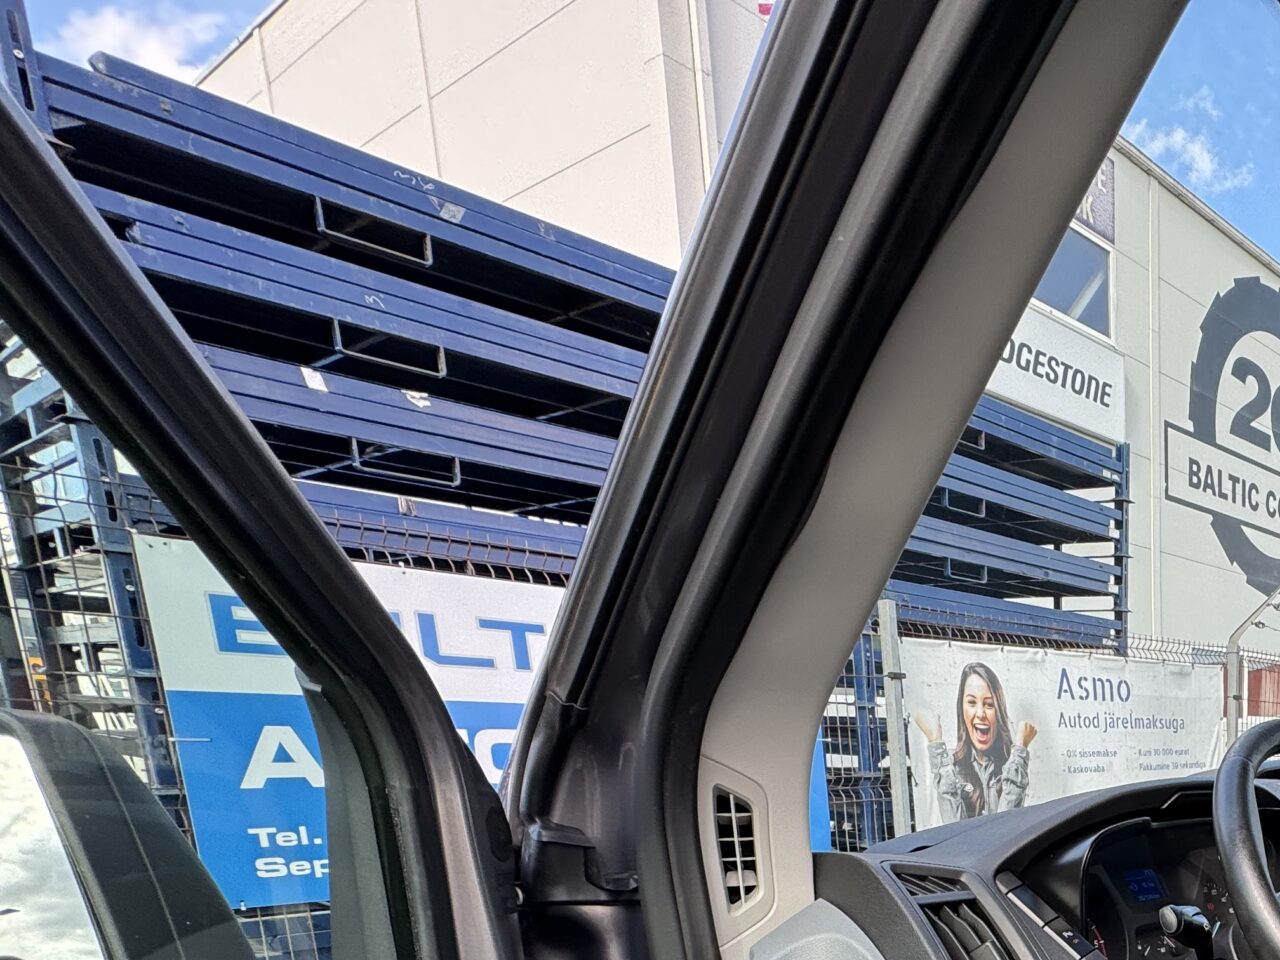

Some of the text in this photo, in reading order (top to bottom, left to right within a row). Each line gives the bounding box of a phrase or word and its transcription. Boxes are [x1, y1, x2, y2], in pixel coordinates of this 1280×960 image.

[1188, 456, 1260, 512] BALTIC
[1057, 667, 1131, 703] Asmo
[1058, 710, 1185, 733] Autod järelmaksuga
[247, 825, 323, 848] Tel.
